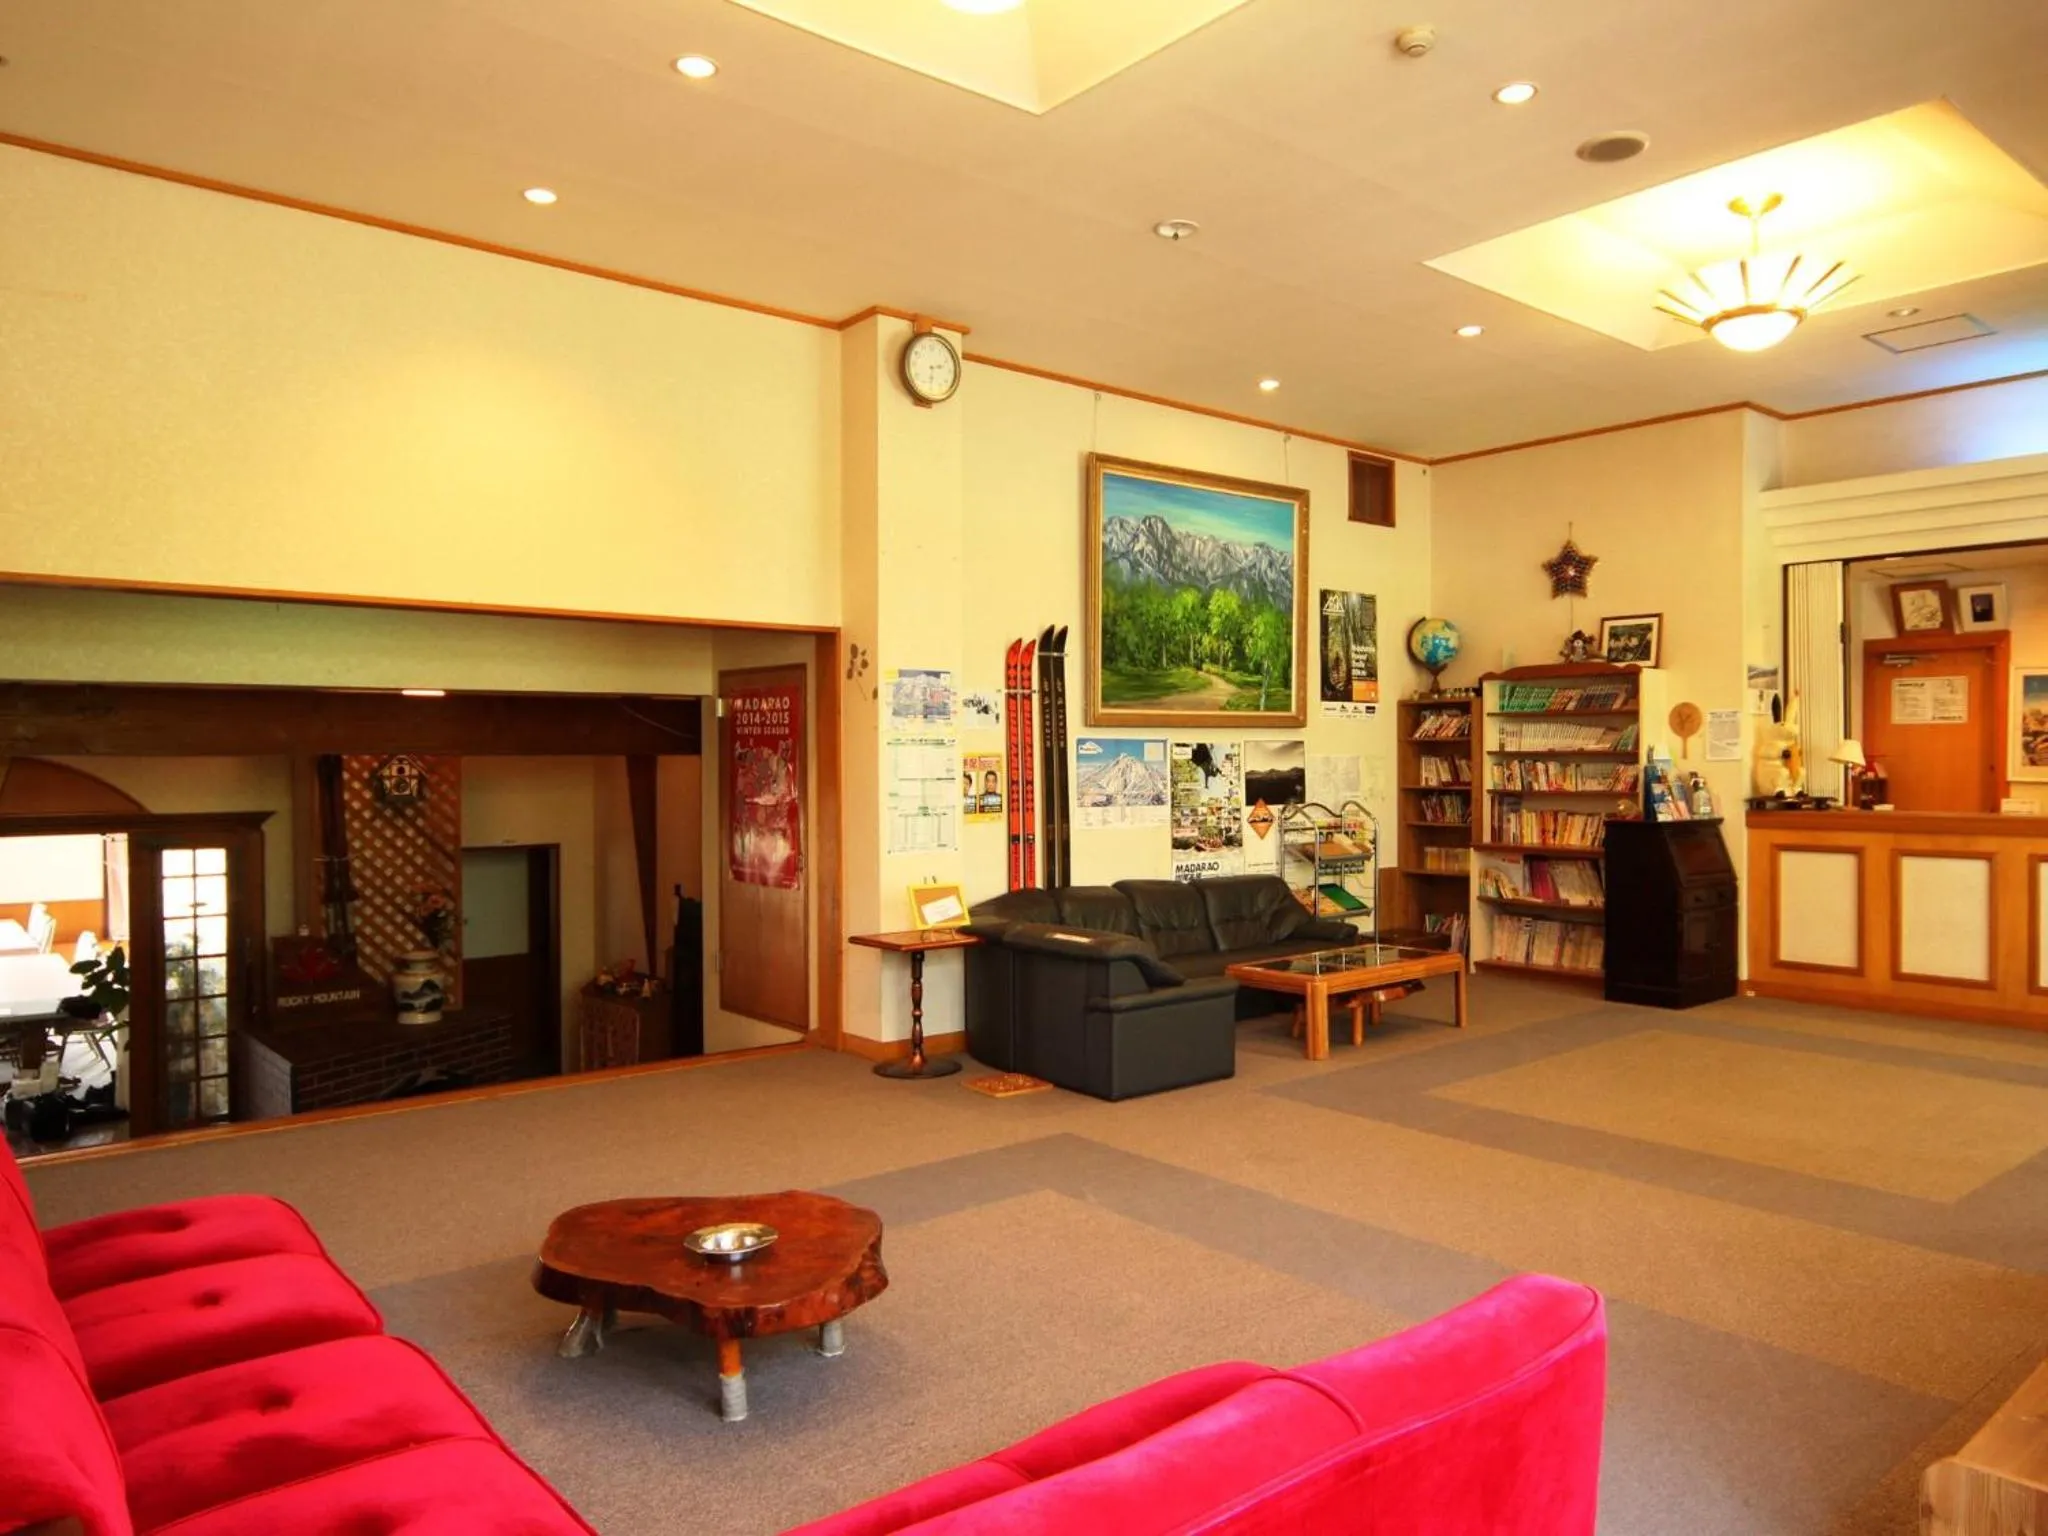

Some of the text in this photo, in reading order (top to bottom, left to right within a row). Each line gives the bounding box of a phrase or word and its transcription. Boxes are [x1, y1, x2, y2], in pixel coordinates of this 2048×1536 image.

[733, 697, 790, 710] MADARAO
[736, 711, 790, 725] 2014-2015
[1175, 861, 1220, 873] MADARAO
[277, 989, 360, 1007] ROCKY MOUNTAIN
